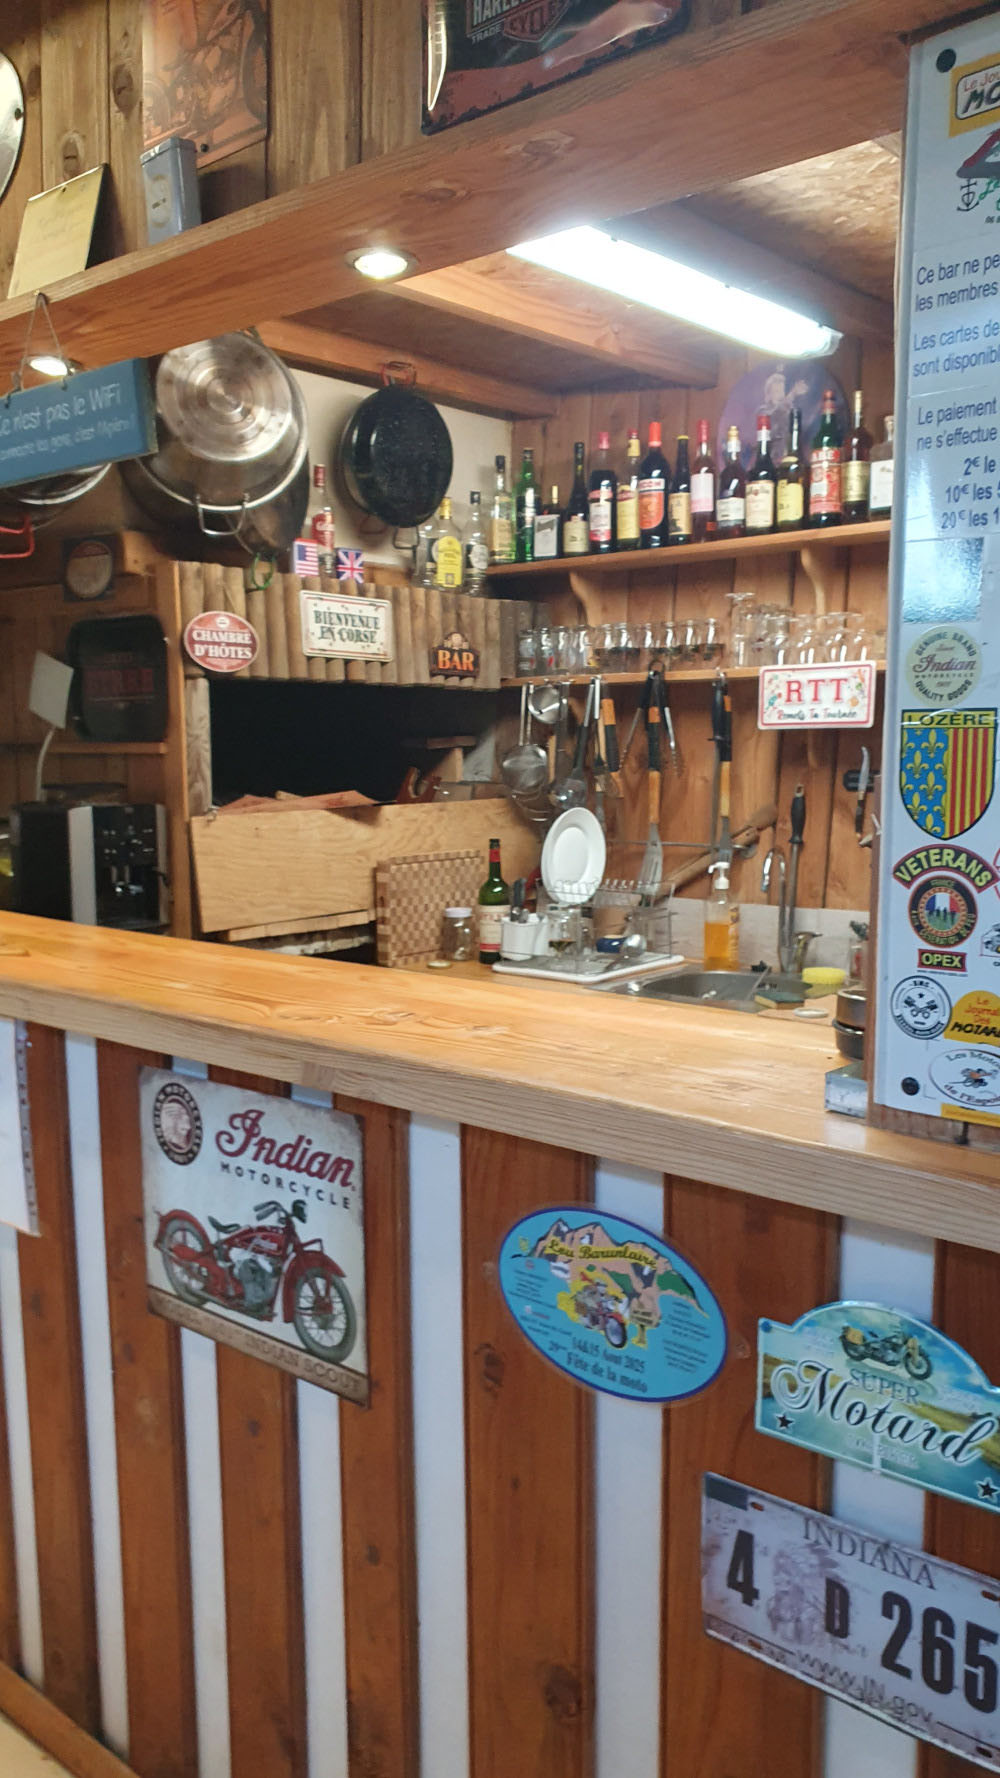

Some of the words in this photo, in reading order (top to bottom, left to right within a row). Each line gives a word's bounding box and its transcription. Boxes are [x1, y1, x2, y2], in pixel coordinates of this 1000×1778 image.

[916, 266, 935, 286] Ce
[938, 261, 960, 281] bar
[962, 257, 980, 275] ne
[914, 293, 934, 313] les
[937, 281, 999, 306] membres
[914, 332, 937, 352] Les
[940, 325, 980, 347] cartes
[983, 319, 1000, 338] de
[913, 356, 940, 377] sont
[46, 403, 70, 431] pas
[73, 395, 86, 416] le
[918, 406, 935, 427] Le
[937, 398, 997, 428] paiement
[916, 435, 933, 451] ne
[935, 425, 998, 450] s'effectue
[963, 456, 980, 476] 2€
[984, 455, 996, 474] le
[945, 483, 969, 504] 10€
[973, 482, 992, 501] les
[941, 509, 966, 529] 20€
[969, 508, 988, 527] les
[313, 610, 380, 630] BIENVENUE
[192, 629, 252, 644] CHAMBRE
[337, 627, 377, 643] CORSE
[952, 631, 977, 657] BRAND
[194, 642, 252, 659] D'HÔTES
[437, 649, 475, 672] BAR
[912, 653, 977, 673] Indian
[785, 678, 848, 703] RTT
[915, 679, 945, 702] QUALITY
[947, 679, 973, 701] GOODS
[907, 711, 991, 727] LOZÈRE
[896, 848, 992, 887] VETERANS
[921, 952, 962, 968] OPEX
[215, 1108, 355, 1188] Indian
[220, 1160, 351, 1211] MOTORCYCLE
[246, 1336, 299, 1367] INDIAN
[304, 1358, 360, 1393] SCOUT
[850, 1368, 921, 1405] SUPER
[771, 1359, 996, 1467] Motard
[803, 1517, 937, 1591] INDIANA
[727, 1529, 760, 1607] 4
[881, 1590, 999, 1714] 265
